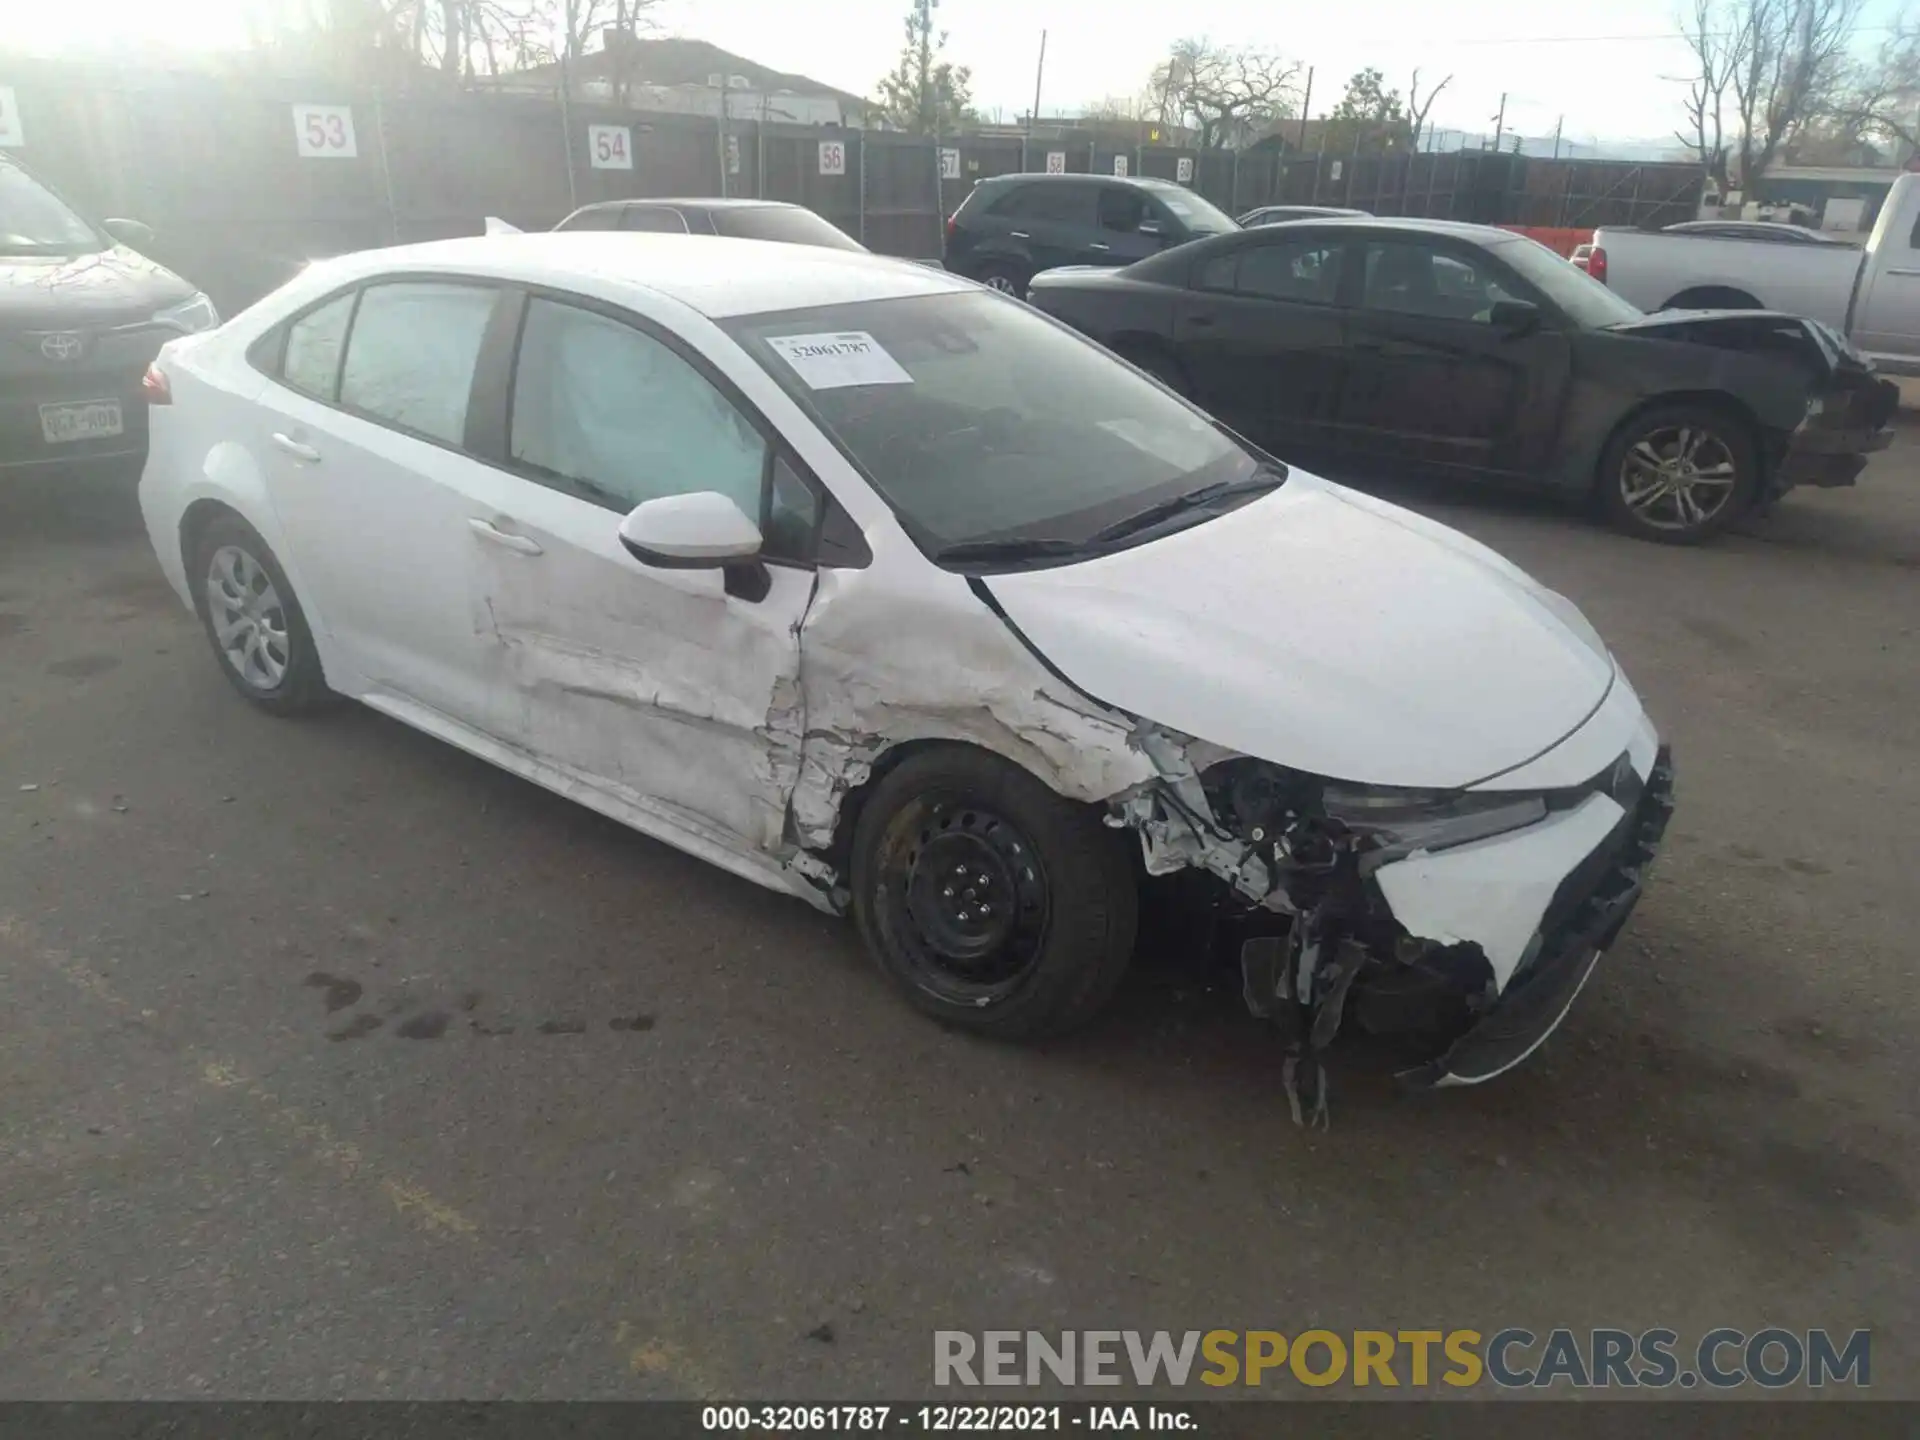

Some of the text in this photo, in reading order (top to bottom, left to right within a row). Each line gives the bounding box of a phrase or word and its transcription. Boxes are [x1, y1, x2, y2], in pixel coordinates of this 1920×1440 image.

[305, 113, 347, 149] 53
[597, 131, 626, 162] 54
[823, 145, 841, 170] 56
[790, 343, 871, 358] 32061787
